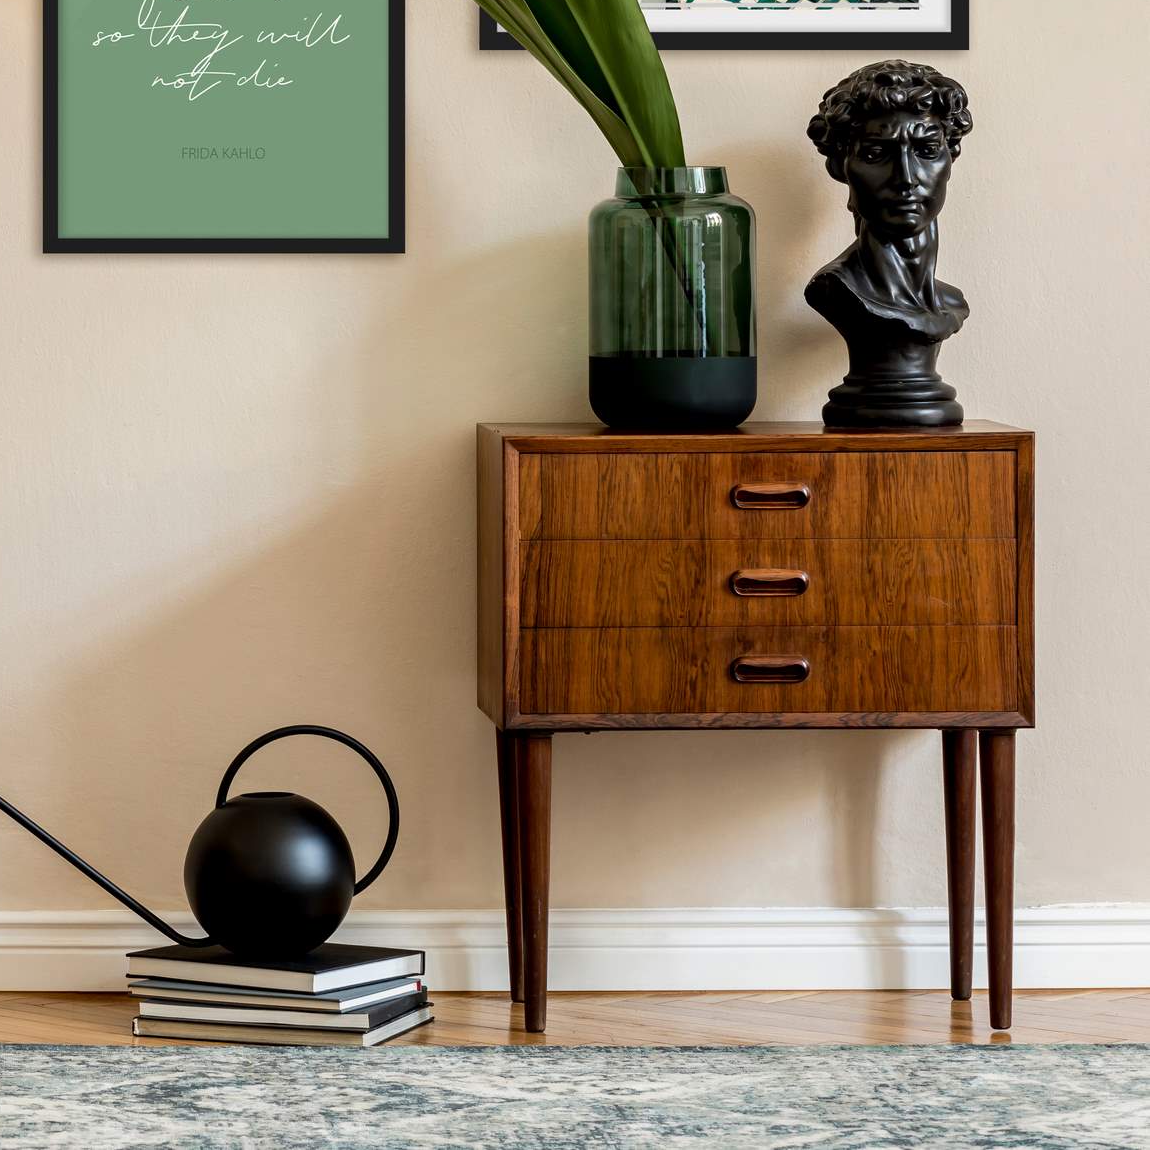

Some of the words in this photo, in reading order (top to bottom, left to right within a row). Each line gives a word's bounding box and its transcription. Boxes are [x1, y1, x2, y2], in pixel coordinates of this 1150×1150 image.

[91, 30, 136, 48] so
[145, 5, 245, 78] they
[255, 12, 351, 48] will
[150, 61, 237, 102] not
[235, 58, 294, 89] die
[180, 146, 219, 160] FRIDA
[221, 146, 266, 161] KAHLO
